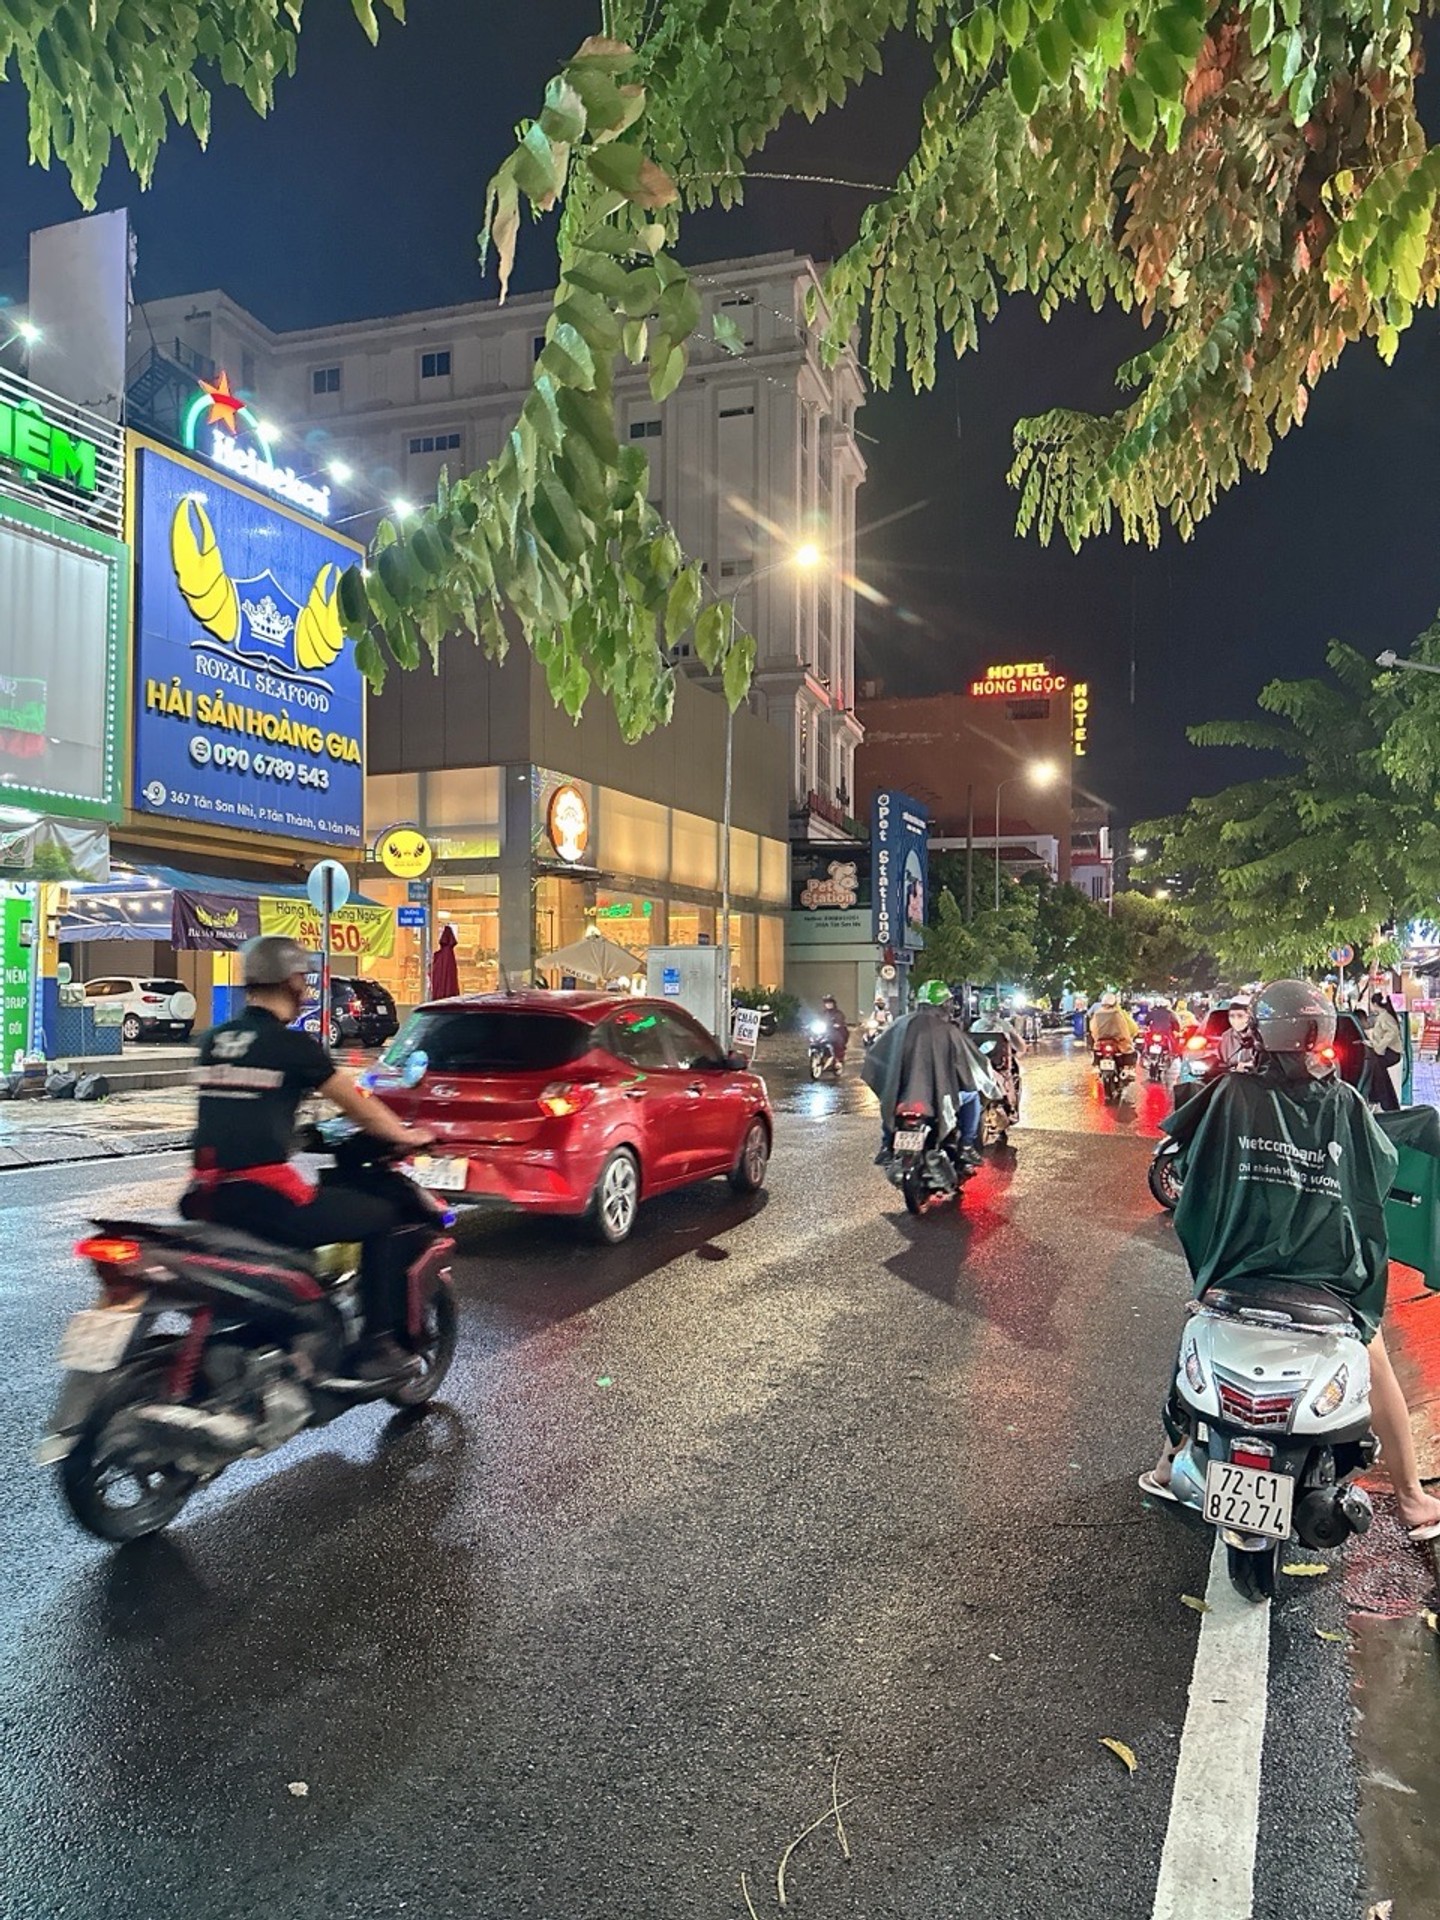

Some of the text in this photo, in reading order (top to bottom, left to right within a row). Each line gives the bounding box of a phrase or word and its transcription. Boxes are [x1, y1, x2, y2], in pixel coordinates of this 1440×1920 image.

[195, 654, 330, 713] ROYAL SEAFOOD
[987, 663, 1050, 679] HOTEL
[1021, 676, 1067, 693] NGỌC
[147, 676, 362, 763] HẢI SẢN HOÀNG GIA
[1073, 683, 1088, 756] HOTEL
[213, 743, 329, 789] 090 6789 543
[170, 791, 190, 807] 367
[193, 794, 213, 810] Tân
[878, 807, 890, 931] Pet Station
[803, 890, 855, 904] Station
[809, 880, 834, 892] Pet
[5, 996, 27, 1009] DRAP
[1238, 1136, 1327, 1164] Vietcombank
[1221, 1468, 1278, 1503] 72-C1
[1210, 1493, 1284, 1534] 822.74
